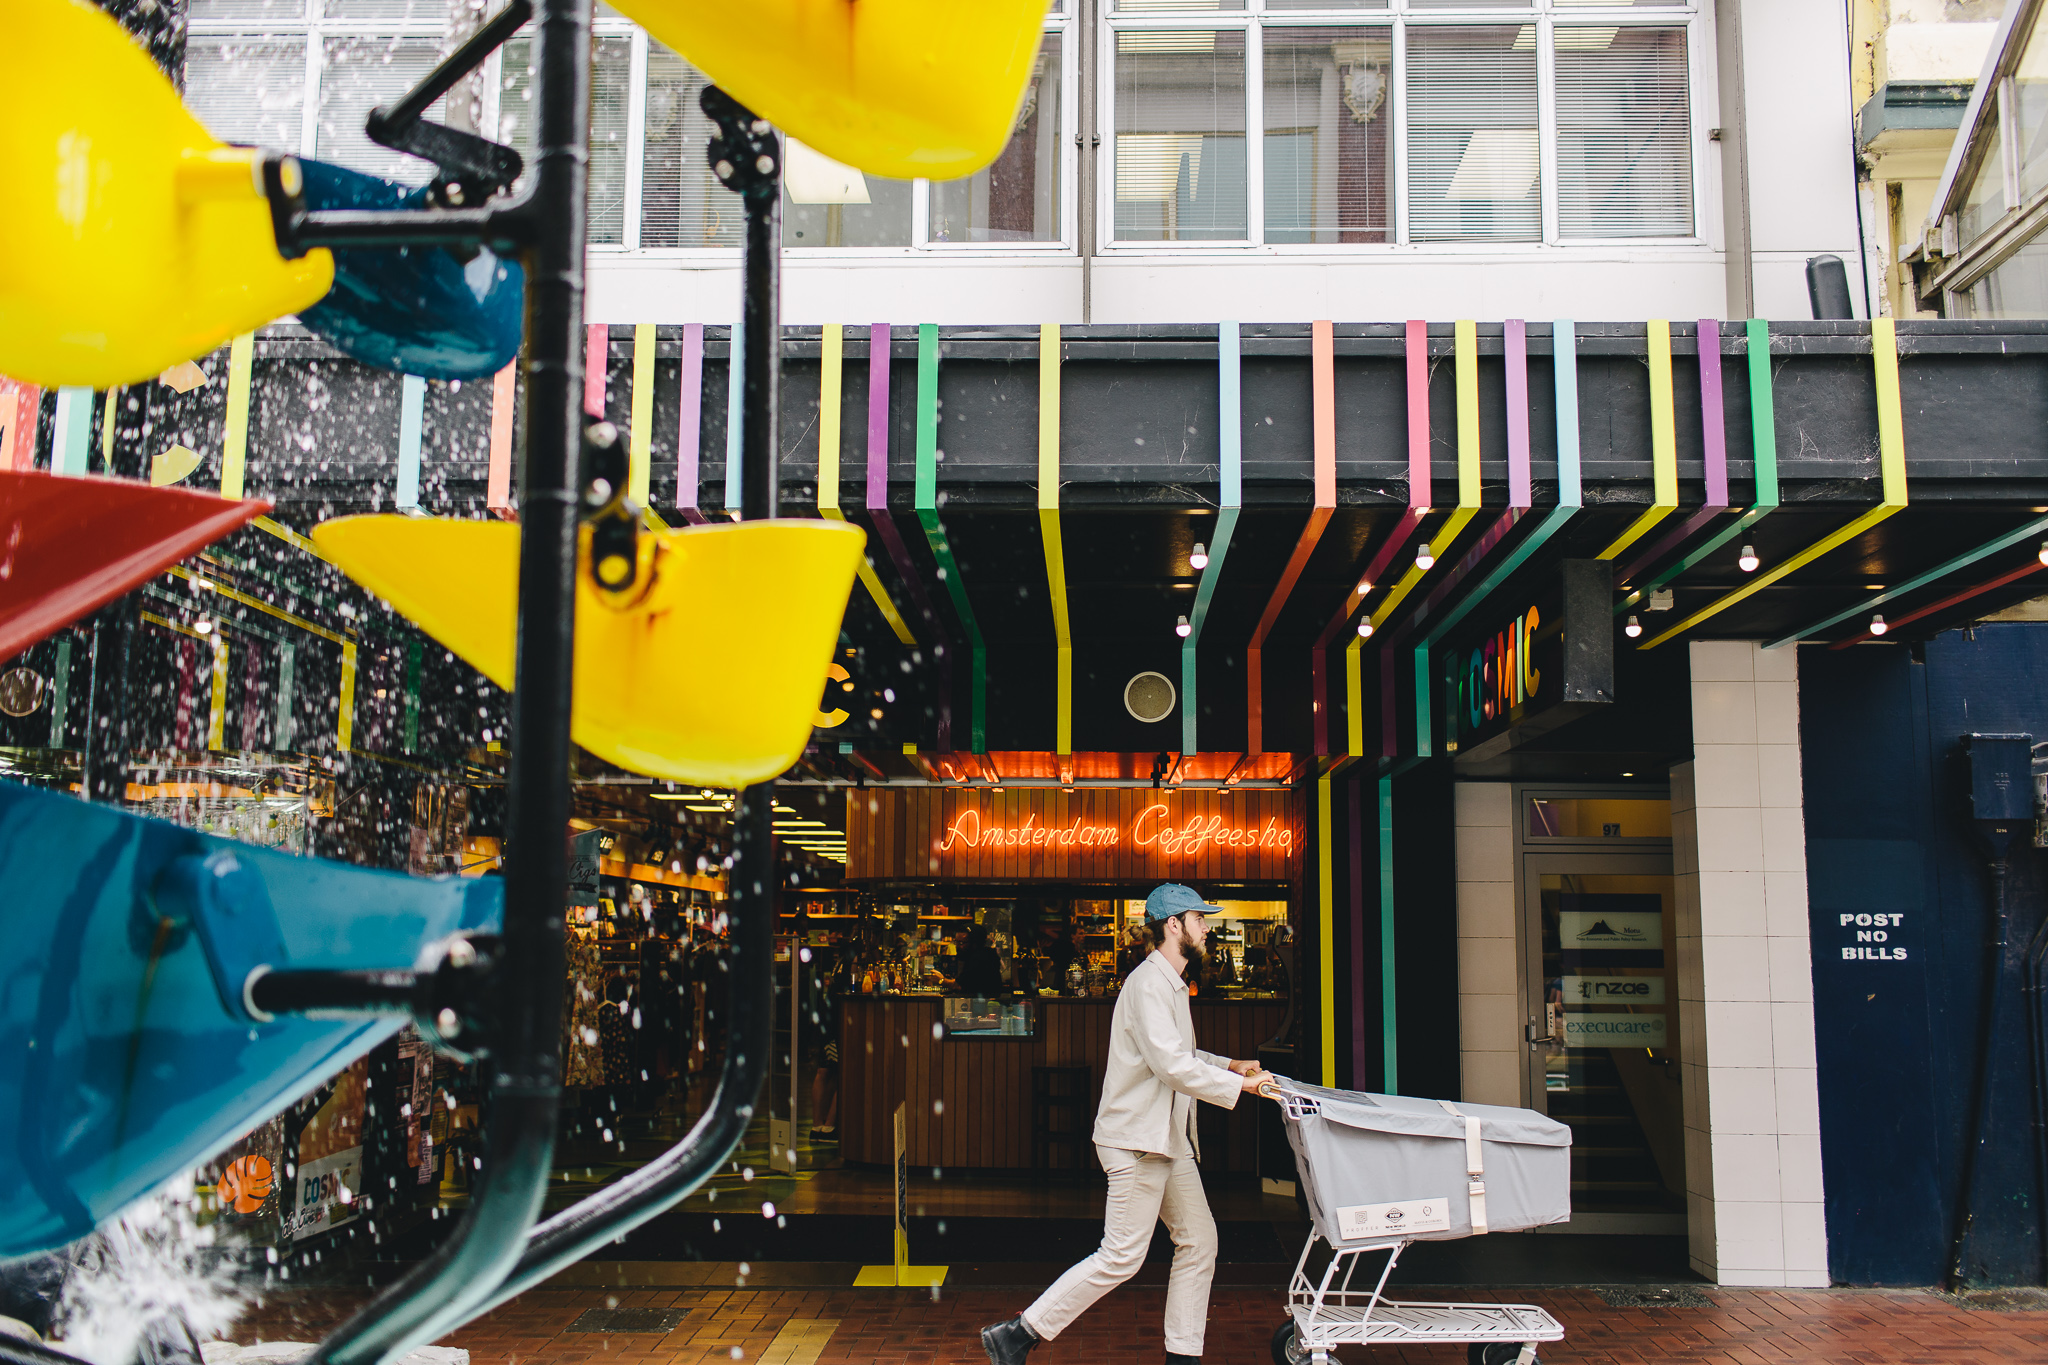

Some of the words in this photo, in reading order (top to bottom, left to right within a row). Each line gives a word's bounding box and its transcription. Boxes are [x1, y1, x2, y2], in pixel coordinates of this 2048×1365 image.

[1458, 604, 1541, 734] COSMIC
[940, 809, 1119, 851] Amsterdam
[1602, 824, 1620, 836] 97
[569, 860, 597, 884] Cigs
[1839, 913, 1904, 927] POST
[1856, 930, 1888, 942] NO
[1841, 946, 1908, 960] BILLS
[1595, 982, 1650, 995] nzae
[1566, 1021, 1651, 1034] execucare
